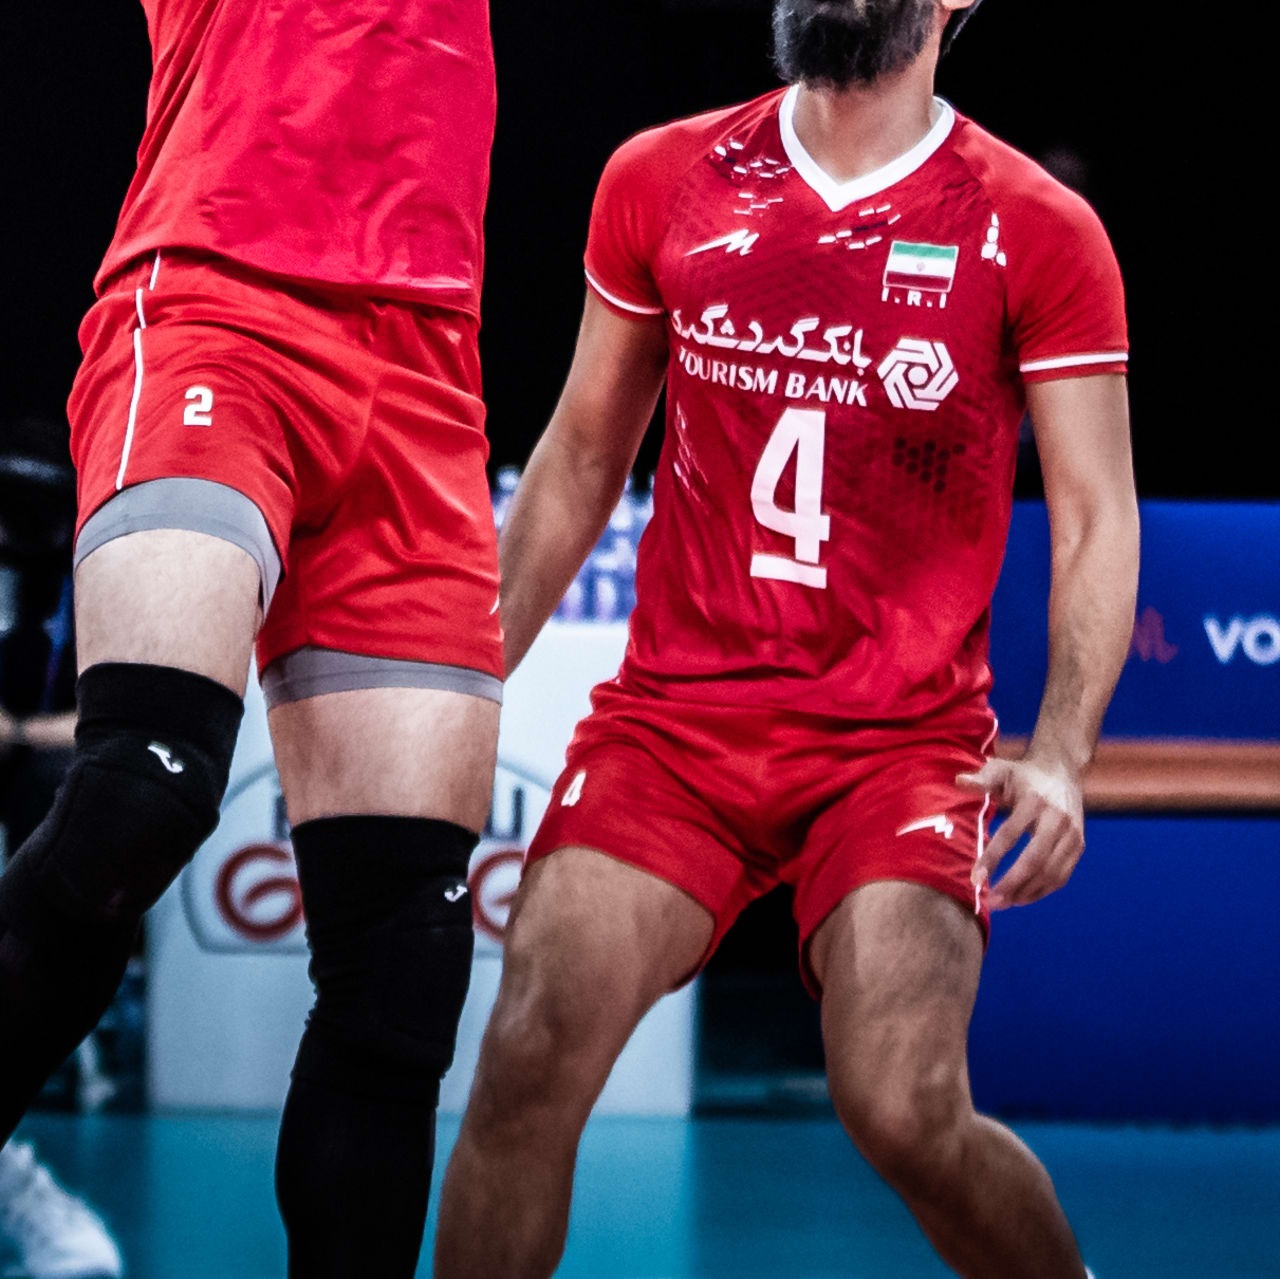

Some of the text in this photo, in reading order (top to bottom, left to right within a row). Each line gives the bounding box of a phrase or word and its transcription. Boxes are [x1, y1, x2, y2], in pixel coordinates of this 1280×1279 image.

[678, 345, 868, 407] TOURISM BANK
[183, 386, 214, 427] 2
[750, 406, 831, 565] 4
[561, 770, 586, 808] 4
